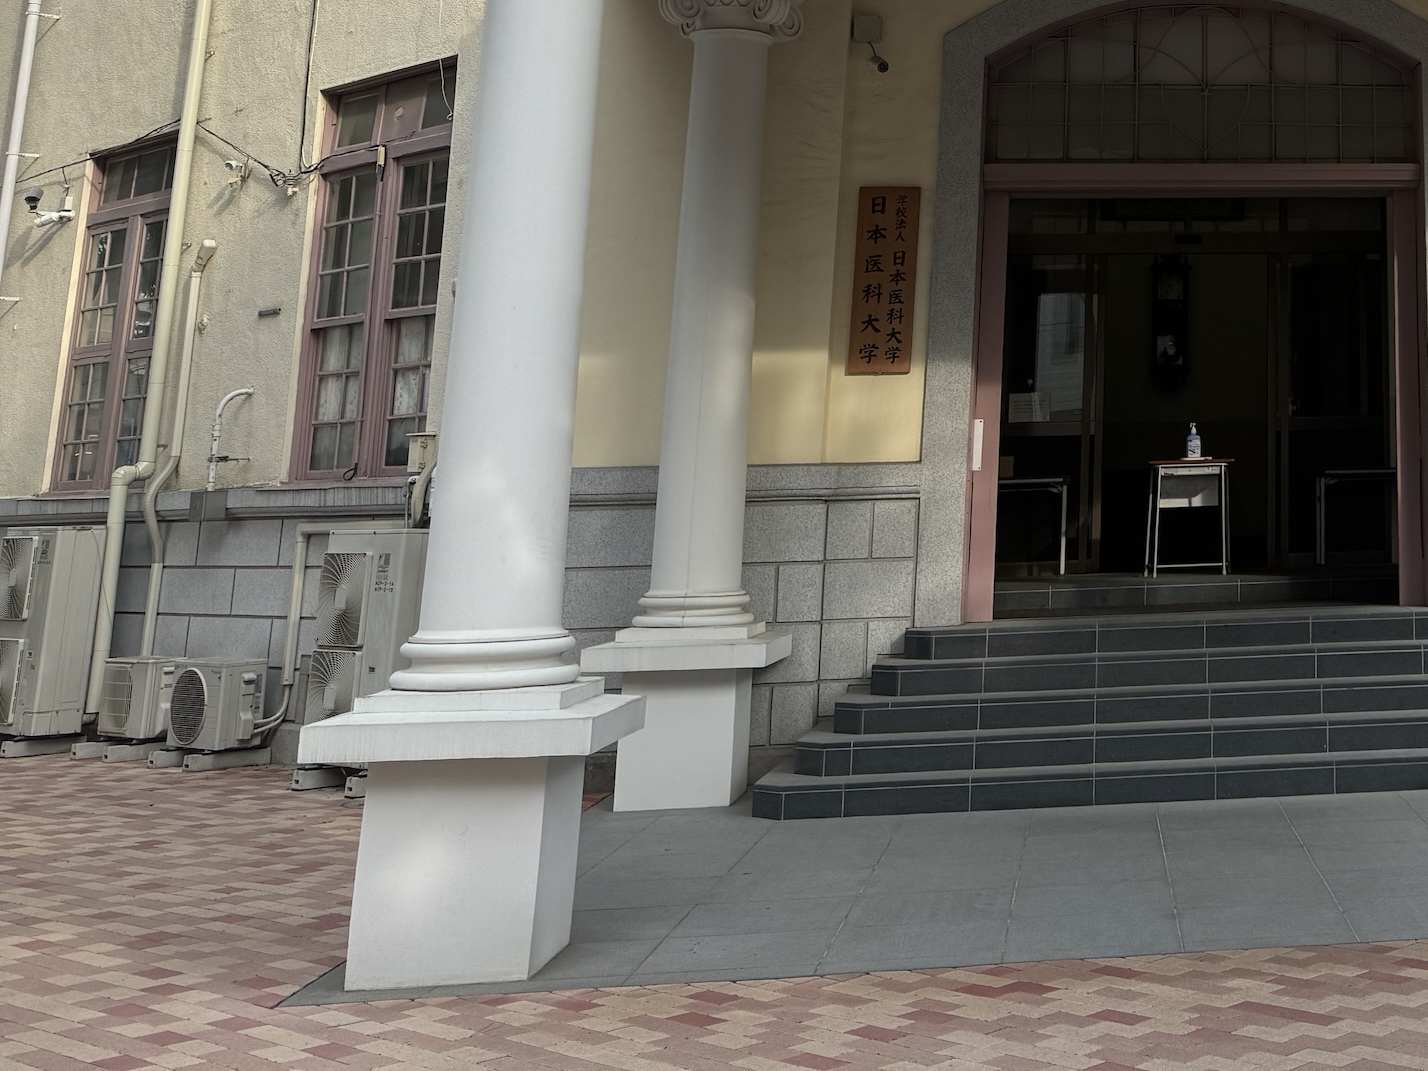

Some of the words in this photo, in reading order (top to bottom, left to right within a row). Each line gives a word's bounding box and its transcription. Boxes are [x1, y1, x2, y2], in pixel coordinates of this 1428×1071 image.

[895, 194, 909, 242] 学校法人
[858, 195, 887, 365] 日本医科大学
[884, 250, 907, 365] 日本医科大学
